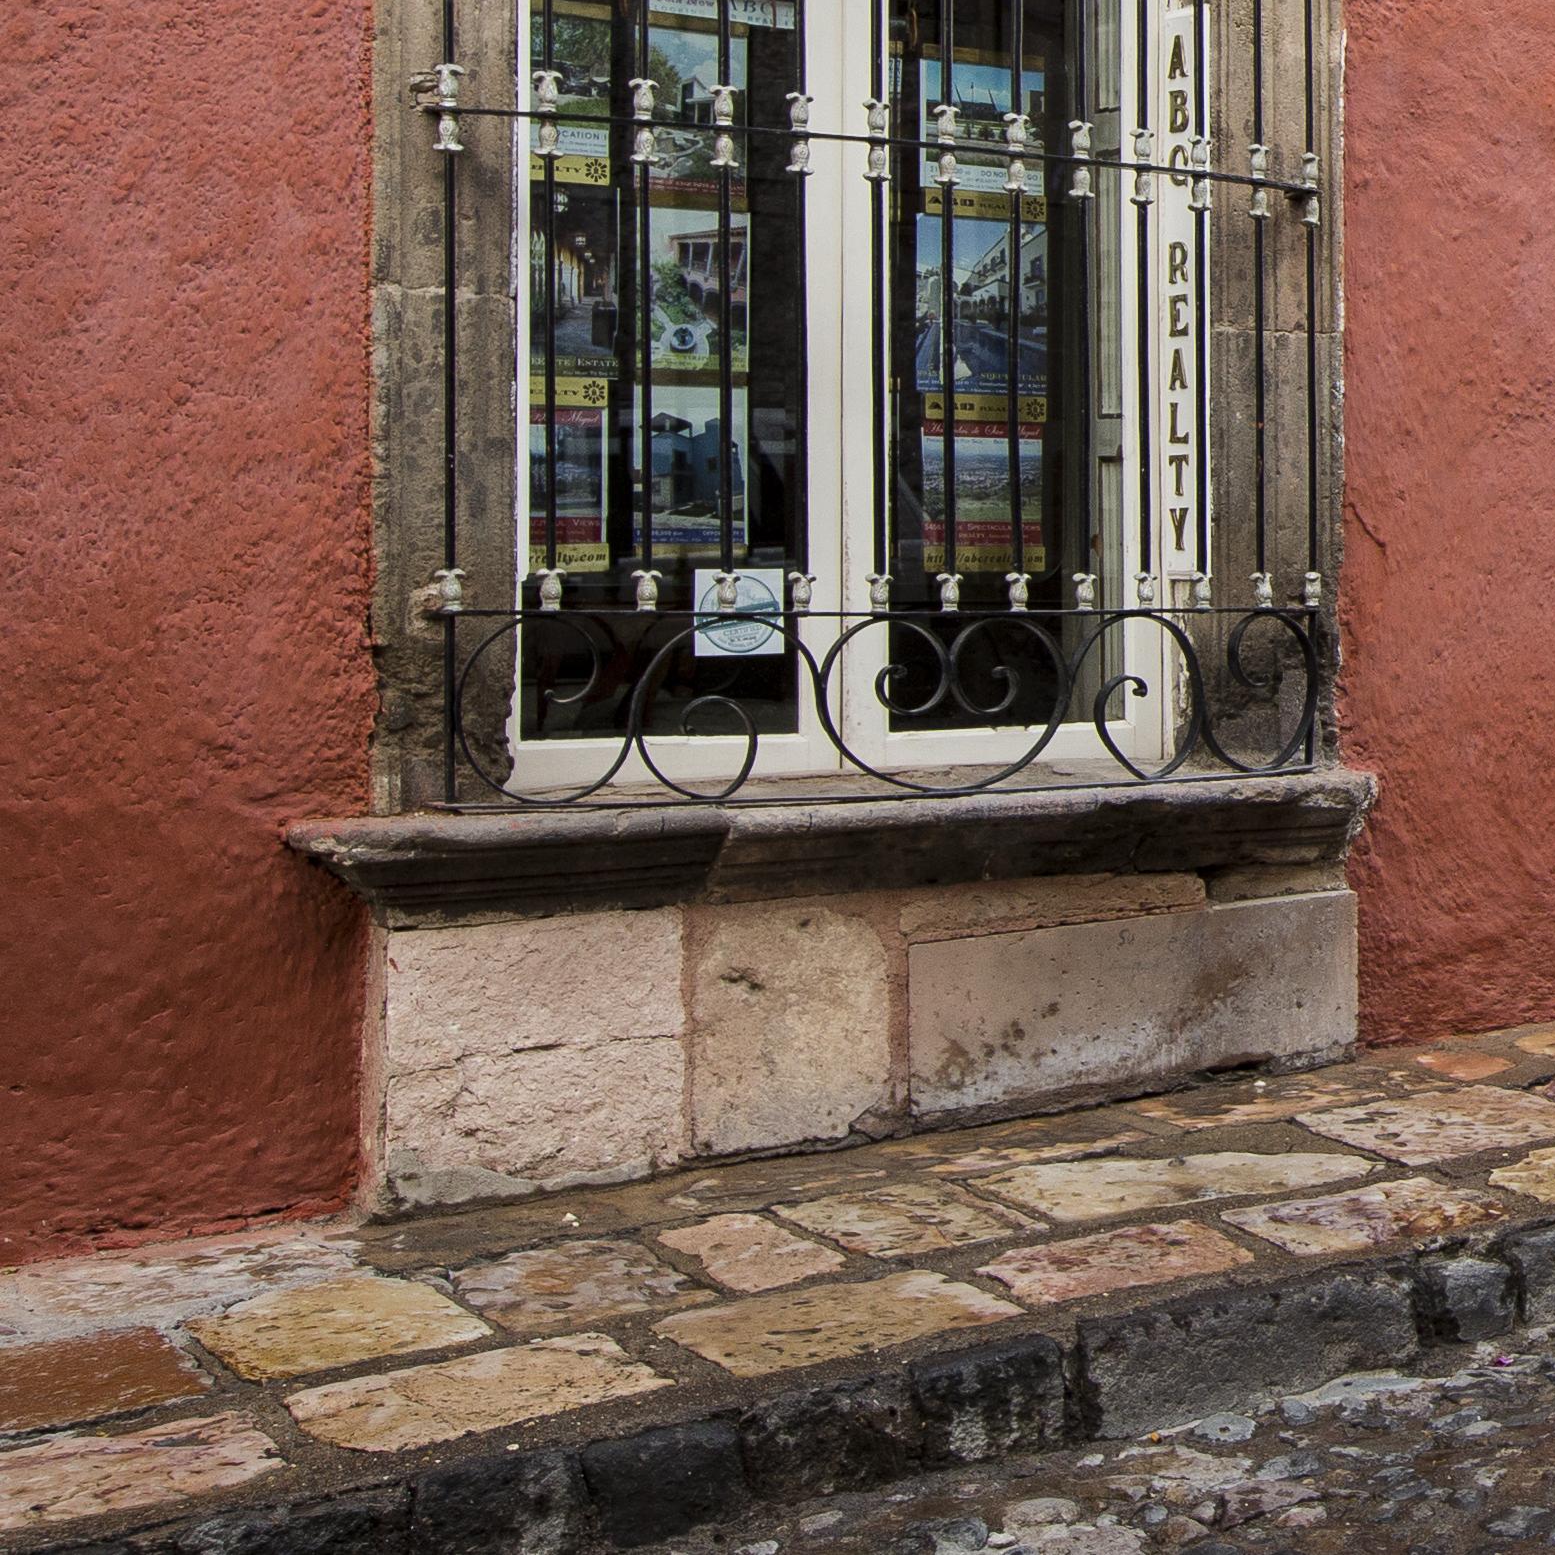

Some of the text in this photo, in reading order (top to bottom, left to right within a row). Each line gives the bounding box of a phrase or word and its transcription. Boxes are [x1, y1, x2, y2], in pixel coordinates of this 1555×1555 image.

[1167, 34, 1189, 187] ABC
[1167, 241, 1190, 552] REALTY
[529, 551, 607, 565] relty.com
